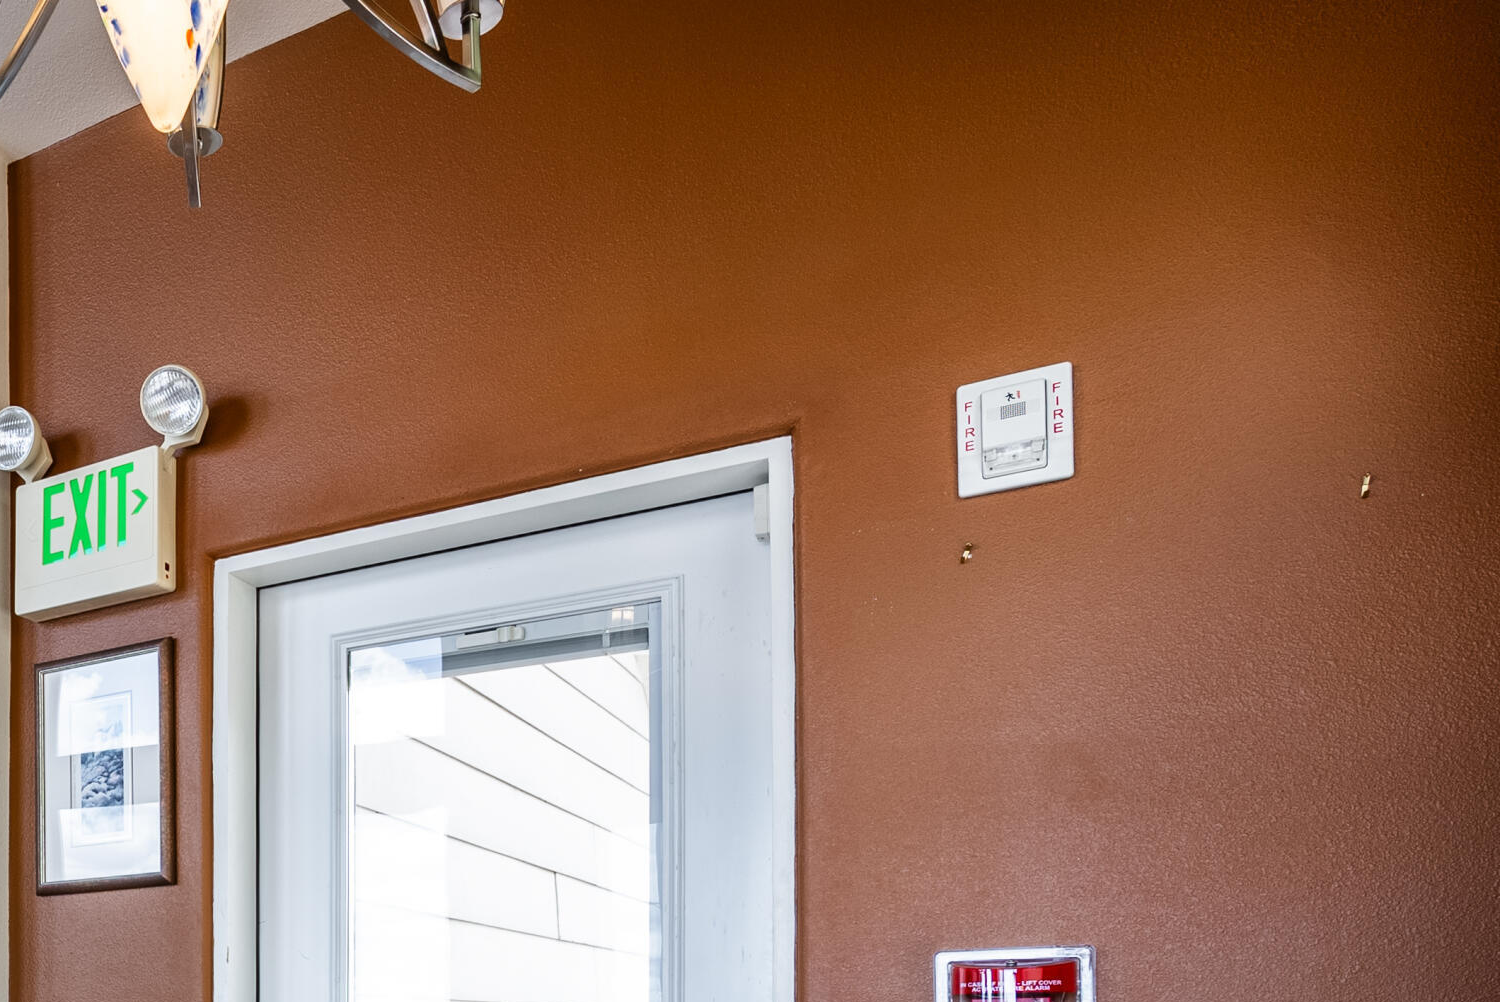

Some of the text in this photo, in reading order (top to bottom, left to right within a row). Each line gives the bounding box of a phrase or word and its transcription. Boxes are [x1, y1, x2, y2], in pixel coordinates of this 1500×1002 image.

[964, 401, 976, 452] FIRE
[1052, 381, 1065, 434] FIRE
[42, 461, 134, 566] EXIT
